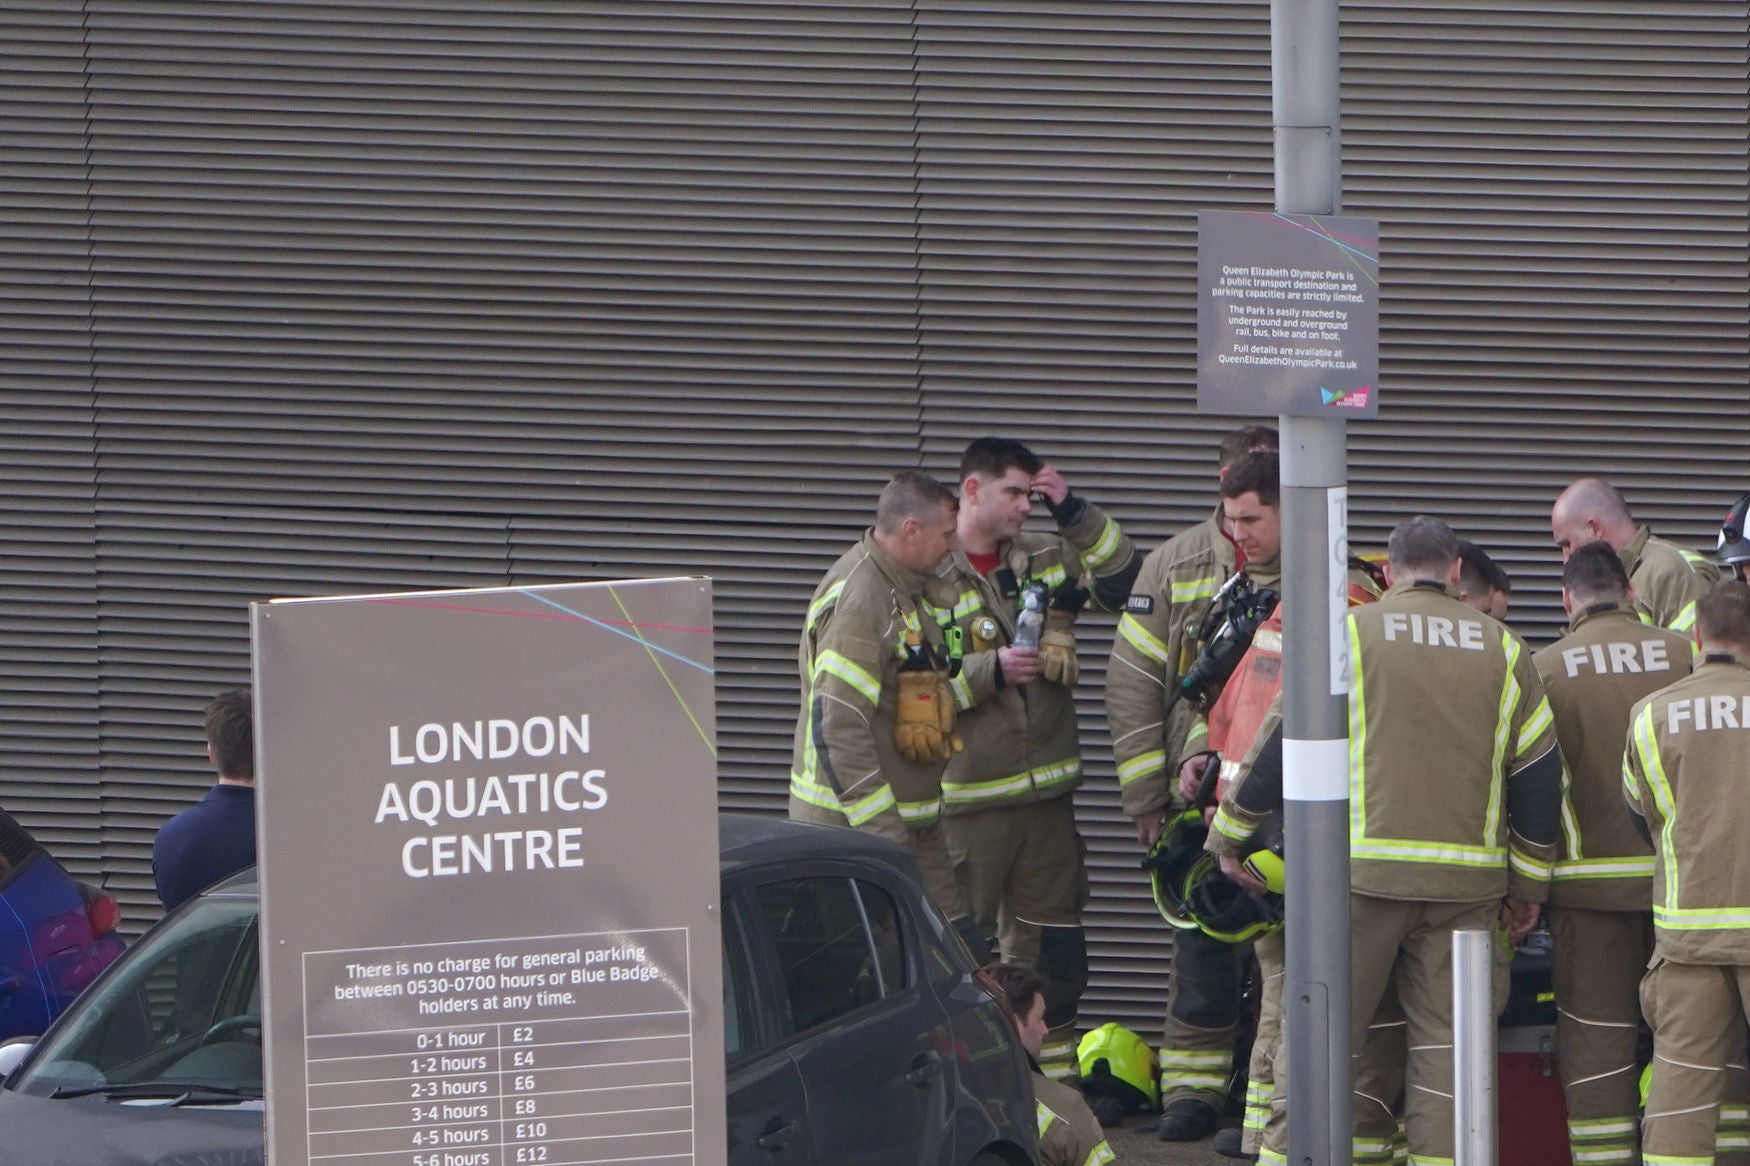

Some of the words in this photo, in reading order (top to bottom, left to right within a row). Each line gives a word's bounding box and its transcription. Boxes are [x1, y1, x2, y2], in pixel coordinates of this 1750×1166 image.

[1222, 265, 1249, 275] Queen
[1250, 266, 1289, 278] Elizabeth
[1290, 268, 1324, 279] Olympic
[1326, 270, 1345, 280] Park
[1346, 272, 1354, 281] is
[1218, 353, 1358, 369] QueenElizabethOlympicPark.co.uk
[1383, 612, 1484, 651] FIRE
[1562, 639, 1671, 679] FIRE
[390, 714, 590, 765] LONDON
[374, 769, 608, 826] AQUATICS
[402, 827, 584, 878] CENTRE
[346, 964, 392, 978] There
[396, 961, 409, 976] is
[413, 962, 434, 974] no
[438, 958, 490, 973] charge
[494, 953, 518, 968] for
[522, 950, 580, 970] general
[585, 945, 645, 965] parking
[334, 984, 403, 1000] between
[407, 974, 495, 995] 0530-0700
[500, 974, 545, 988] hours
[549, 972, 566, 985] or
[571, 968, 606, 984] Blue
[610, 966, 659, 982] Badge
[419, 998, 478, 1014] holders
[483, 995, 498, 1010] at
[503, 995, 532, 1010] any
[536, 991, 576, 1006] time.
[417, 1032, 443, 1049] 0-1
[448, 1031, 486, 1046] hour
[513, 1027, 533, 1042] £2
[411, 1058, 437, 1073] 1-2
[441, 1056, 486, 1071] hours
[514, 1051, 534, 1066] £4
[411, 1082, 438, 1098] 2-3
[442, 1081, 487, 1095] hours
[515, 1075, 535, 1090] £6
[412, 1106, 439, 1122] 3-4
[443, 1105, 488, 1119] hours
[515, 1099, 536, 1114] £8
[412, 1130, 439, 1145] 4-5
[444, 1129, 489, 1143] hours
[516, 1122, 546, 1138] £10
[444, 1153, 490, 1166] hours
[516, 1146, 547, 1162] £12
